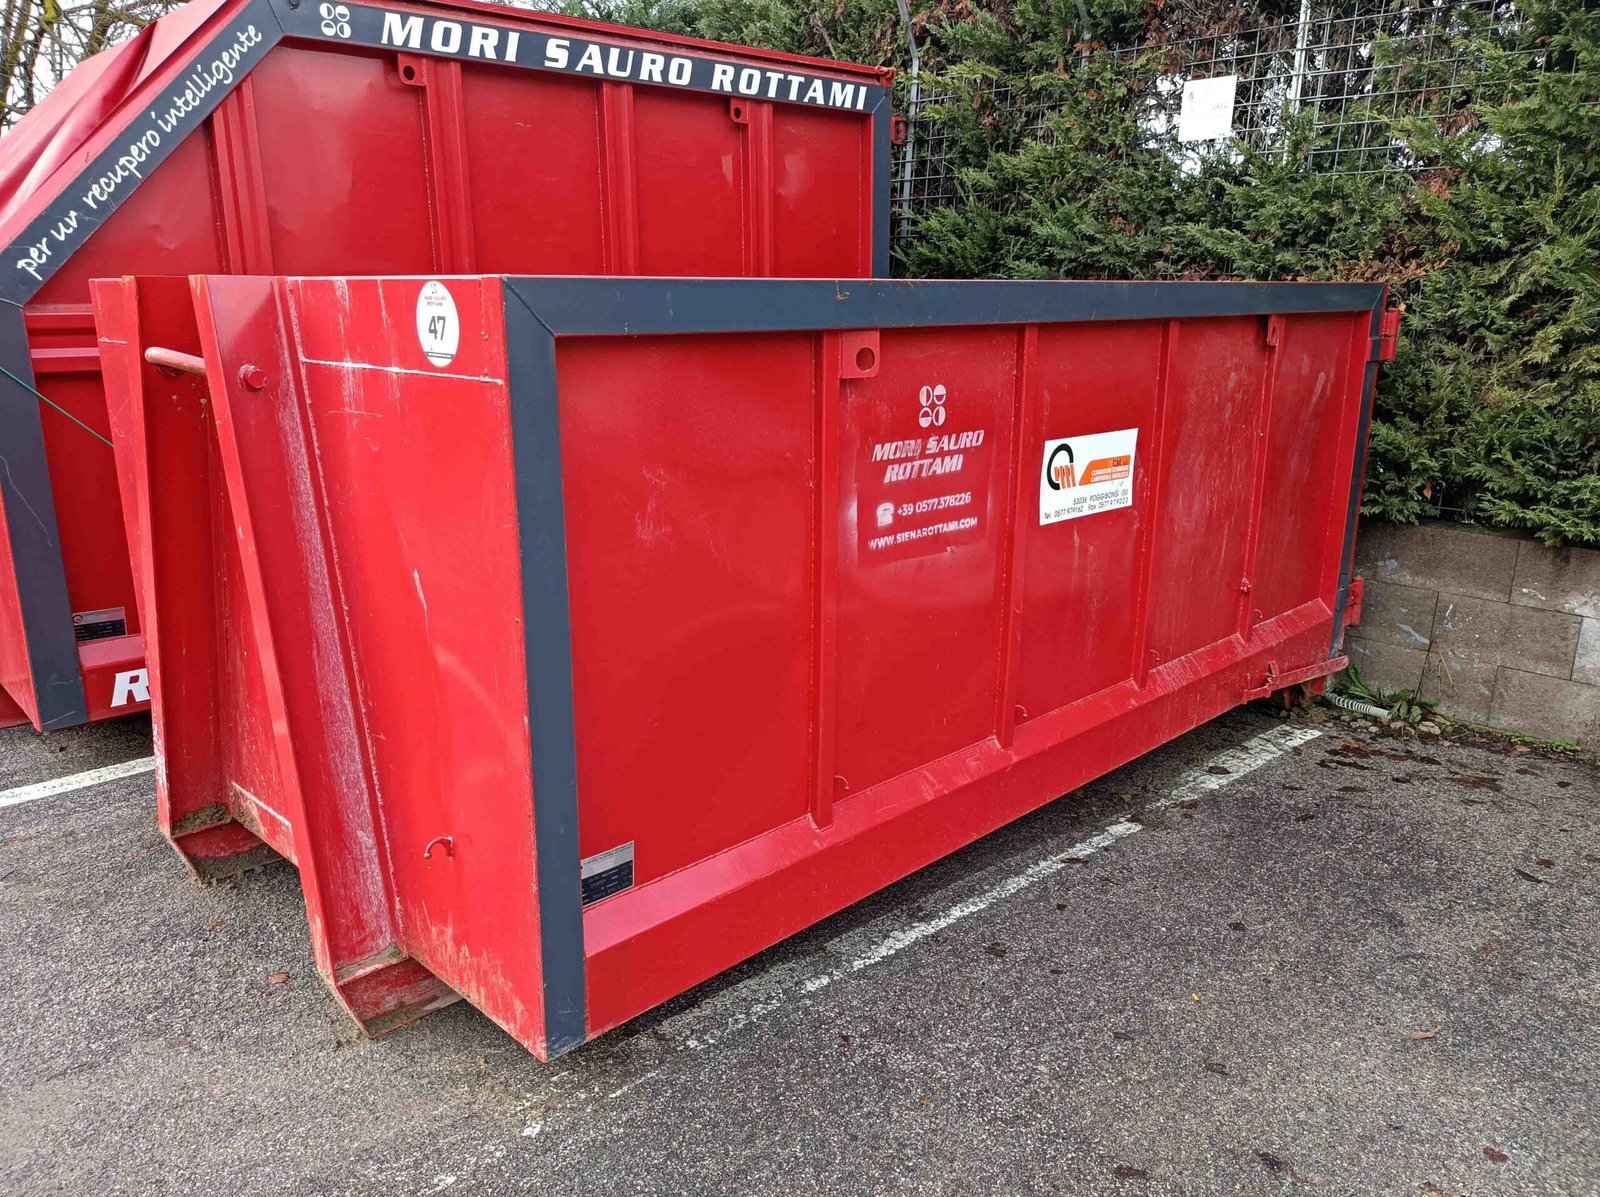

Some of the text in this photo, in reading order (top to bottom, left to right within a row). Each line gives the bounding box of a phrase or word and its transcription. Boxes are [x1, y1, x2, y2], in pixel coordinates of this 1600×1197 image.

[381, 12, 868, 111] MORI SAURO ROTTAMI
[16, 236, 52, 281] per
[82, 129, 161, 209] recupero
[156, 23, 263, 133] intelligente
[428, 315, 446, 341] 47
[871, 429, 985, 463] MORI SAURO
[883, 454, 964, 484] ROTTAMI
[897, 491, 972, 517] +39 0577.378226
[868, 516, 979, 551] WWW.SIENAROTTAMI.COM
